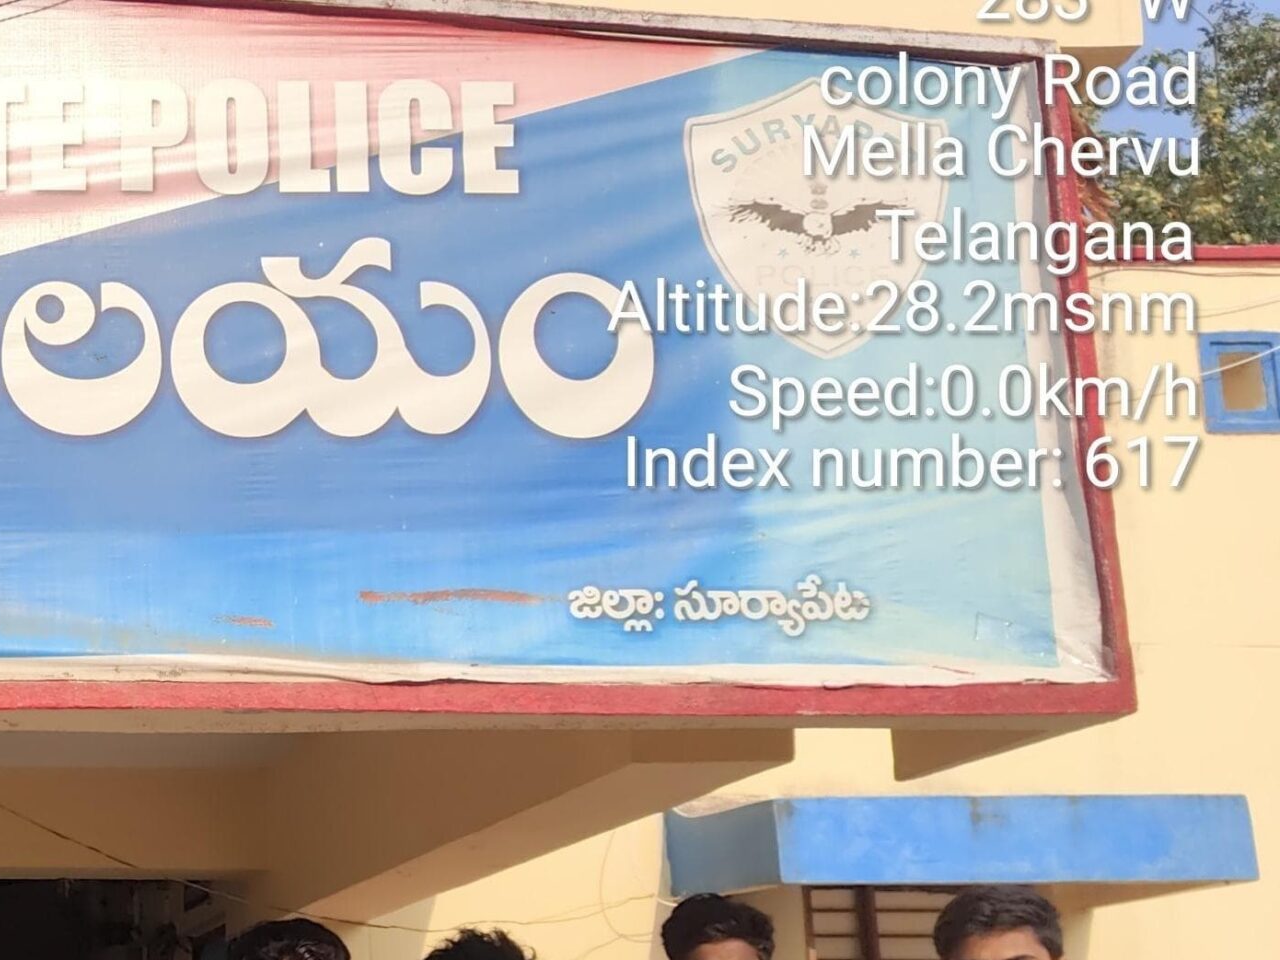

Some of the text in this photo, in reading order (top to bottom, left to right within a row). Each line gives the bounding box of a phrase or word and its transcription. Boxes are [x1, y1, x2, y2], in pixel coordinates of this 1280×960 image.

[120, 77, 520, 196] POLICE
[567, 573, 870, 637] జిల్లా: సూర్యాపేట
